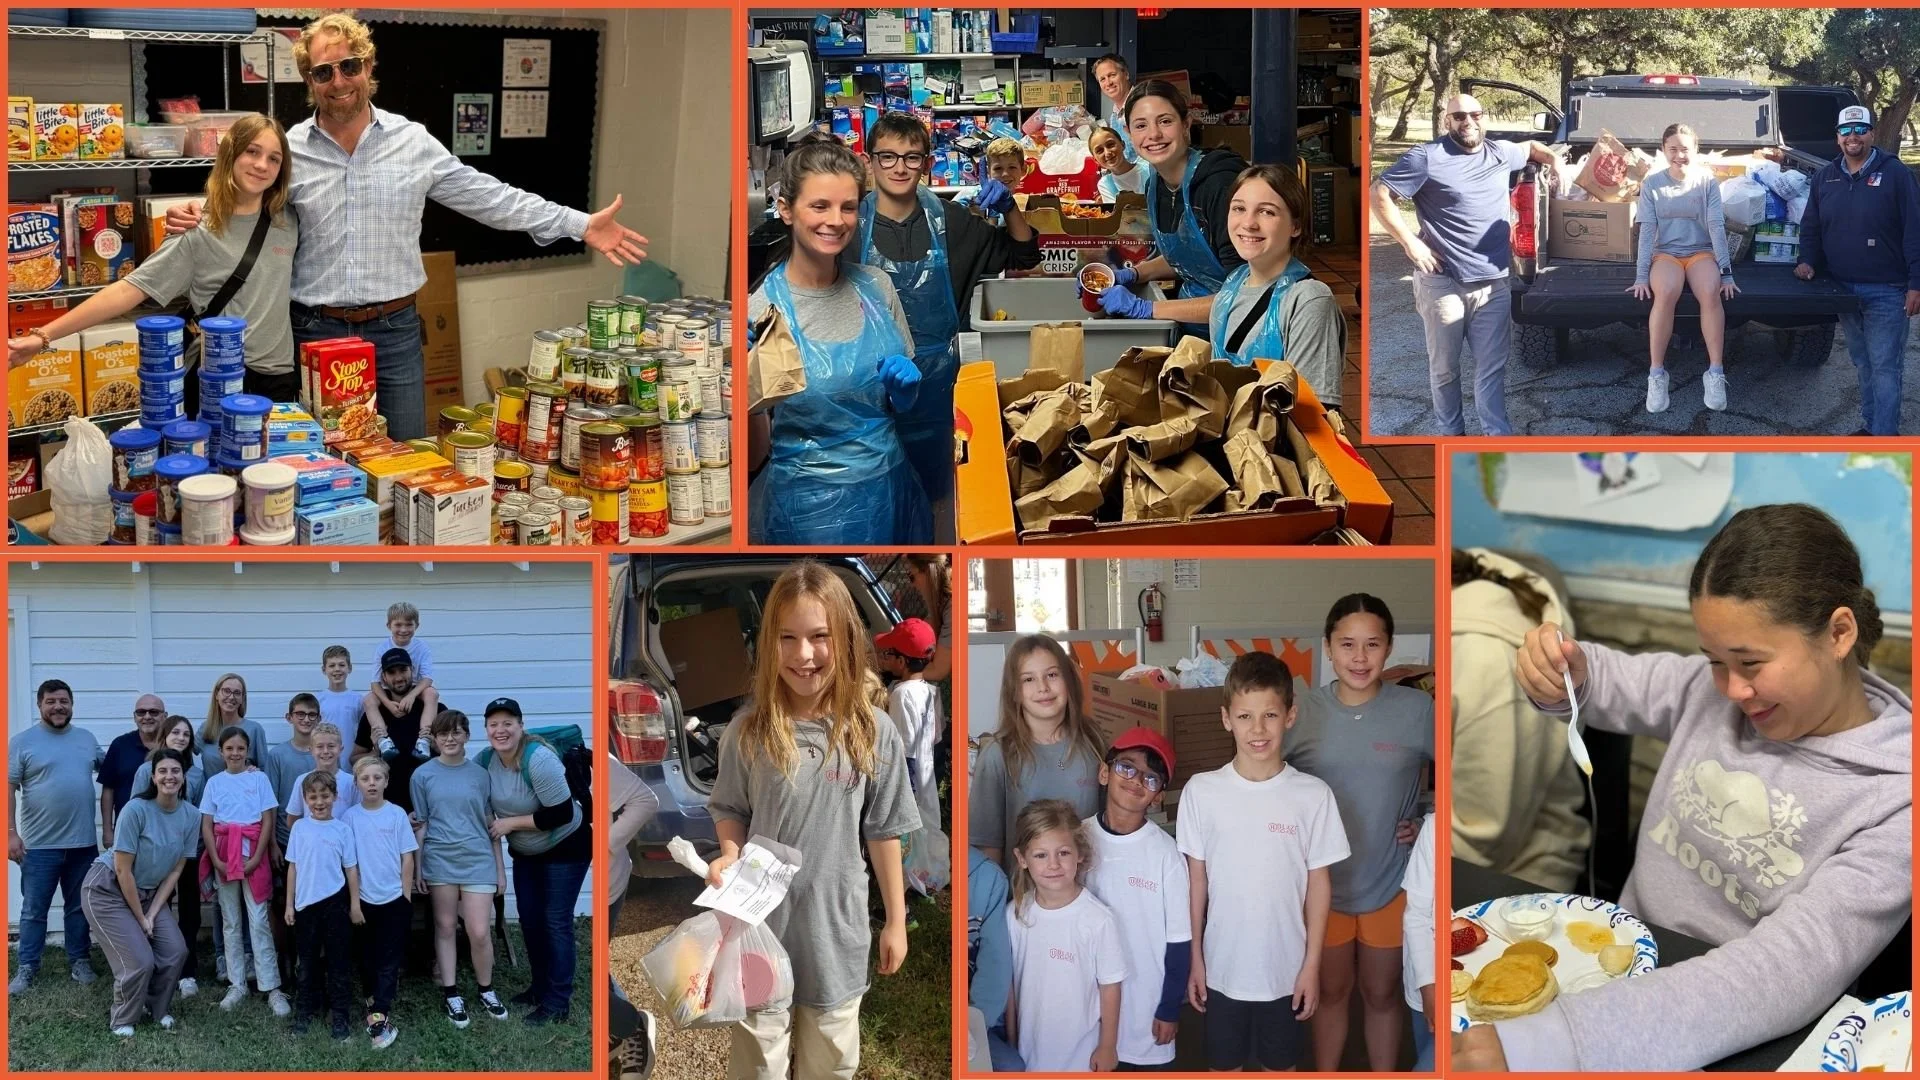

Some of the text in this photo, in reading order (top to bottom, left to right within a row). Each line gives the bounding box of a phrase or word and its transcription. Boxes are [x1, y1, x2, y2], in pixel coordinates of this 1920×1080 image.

[36, 107, 58, 123] Little
[44, 116, 67, 130] Bites
[84, 107, 105, 123] Little
[91, 116, 114, 130] Bites
[1046, 186, 1080, 194] GRAPEFRUIT
[8, 217, 50, 235] ROSTED
[8, 230, 55, 250] FLAKES
[1040, 248, 1077, 262] SMIC
[1043, 262, 1074, 272] CRISP
[91, 344, 137, 361] Toasted
[38, 364, 59, 377] O's
[105, 356, 125, 369] O's
[325, 358, 369, 390] Stove
[339, 375, 363, 396] Top
[9, 485, 32, 495] MINI
[452, 494, 484, 516] Turkey
[1648, 810, 1760, 919] Roots
